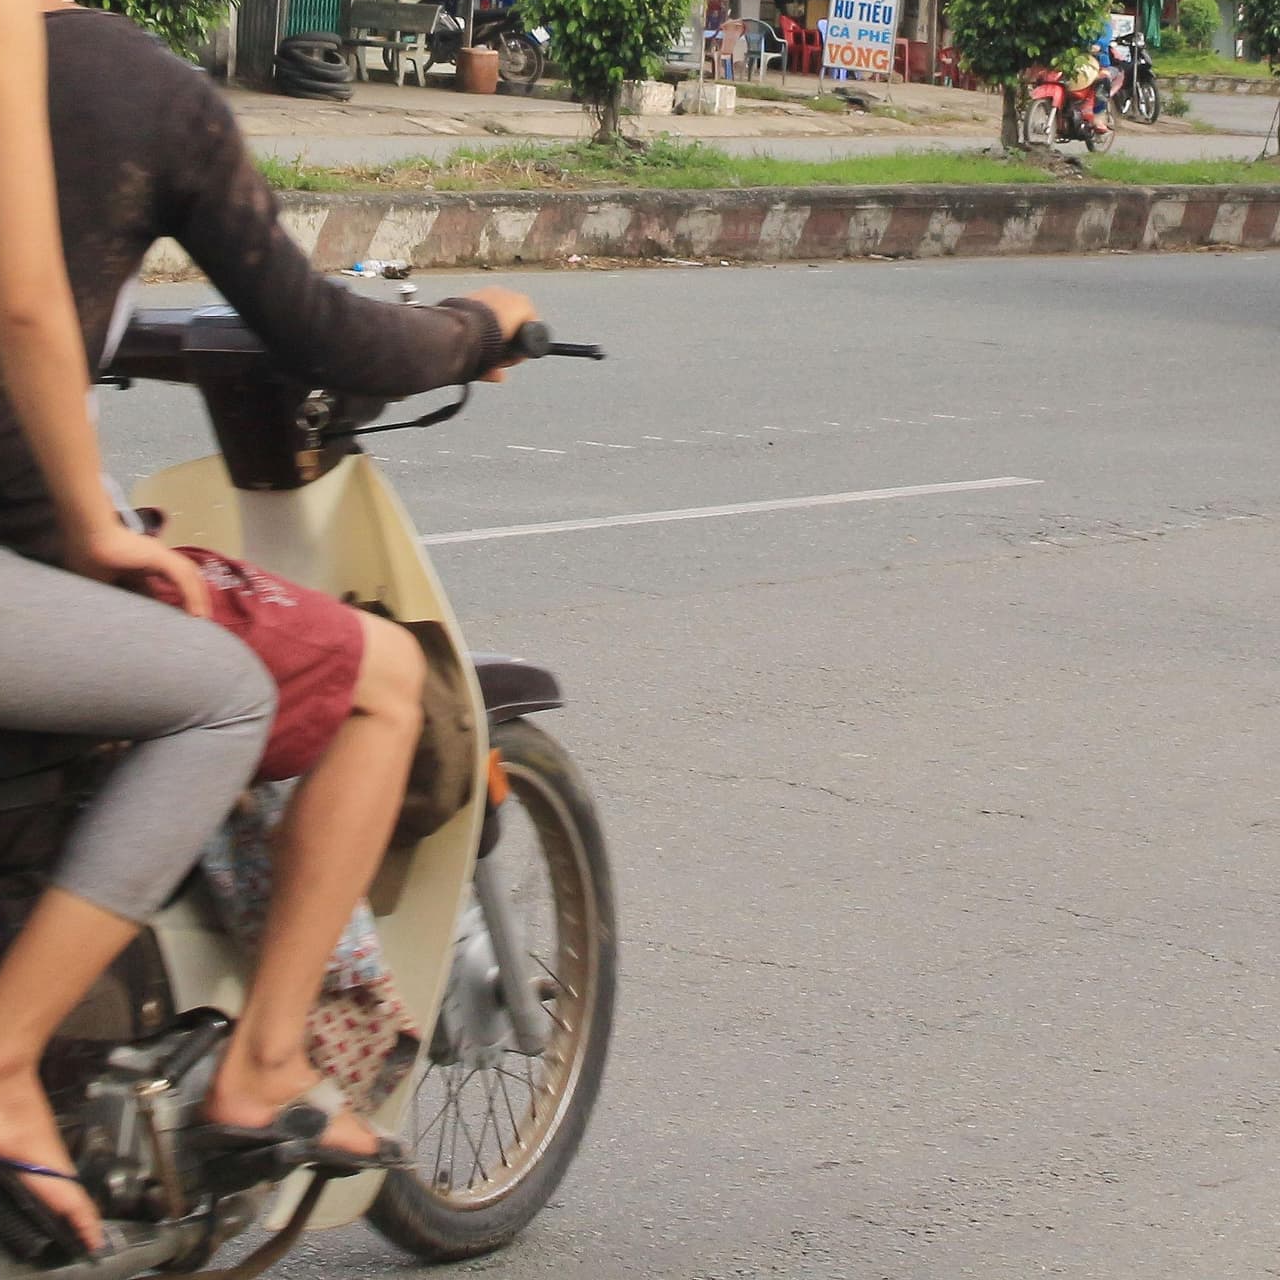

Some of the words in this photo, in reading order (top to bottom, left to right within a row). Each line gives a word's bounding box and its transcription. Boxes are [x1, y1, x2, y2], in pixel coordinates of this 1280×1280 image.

[858, 0, 893, 25] TIẾU
[829, 23, 850, 39] CÀ
[857, 28, 891, 45] PHÊ
